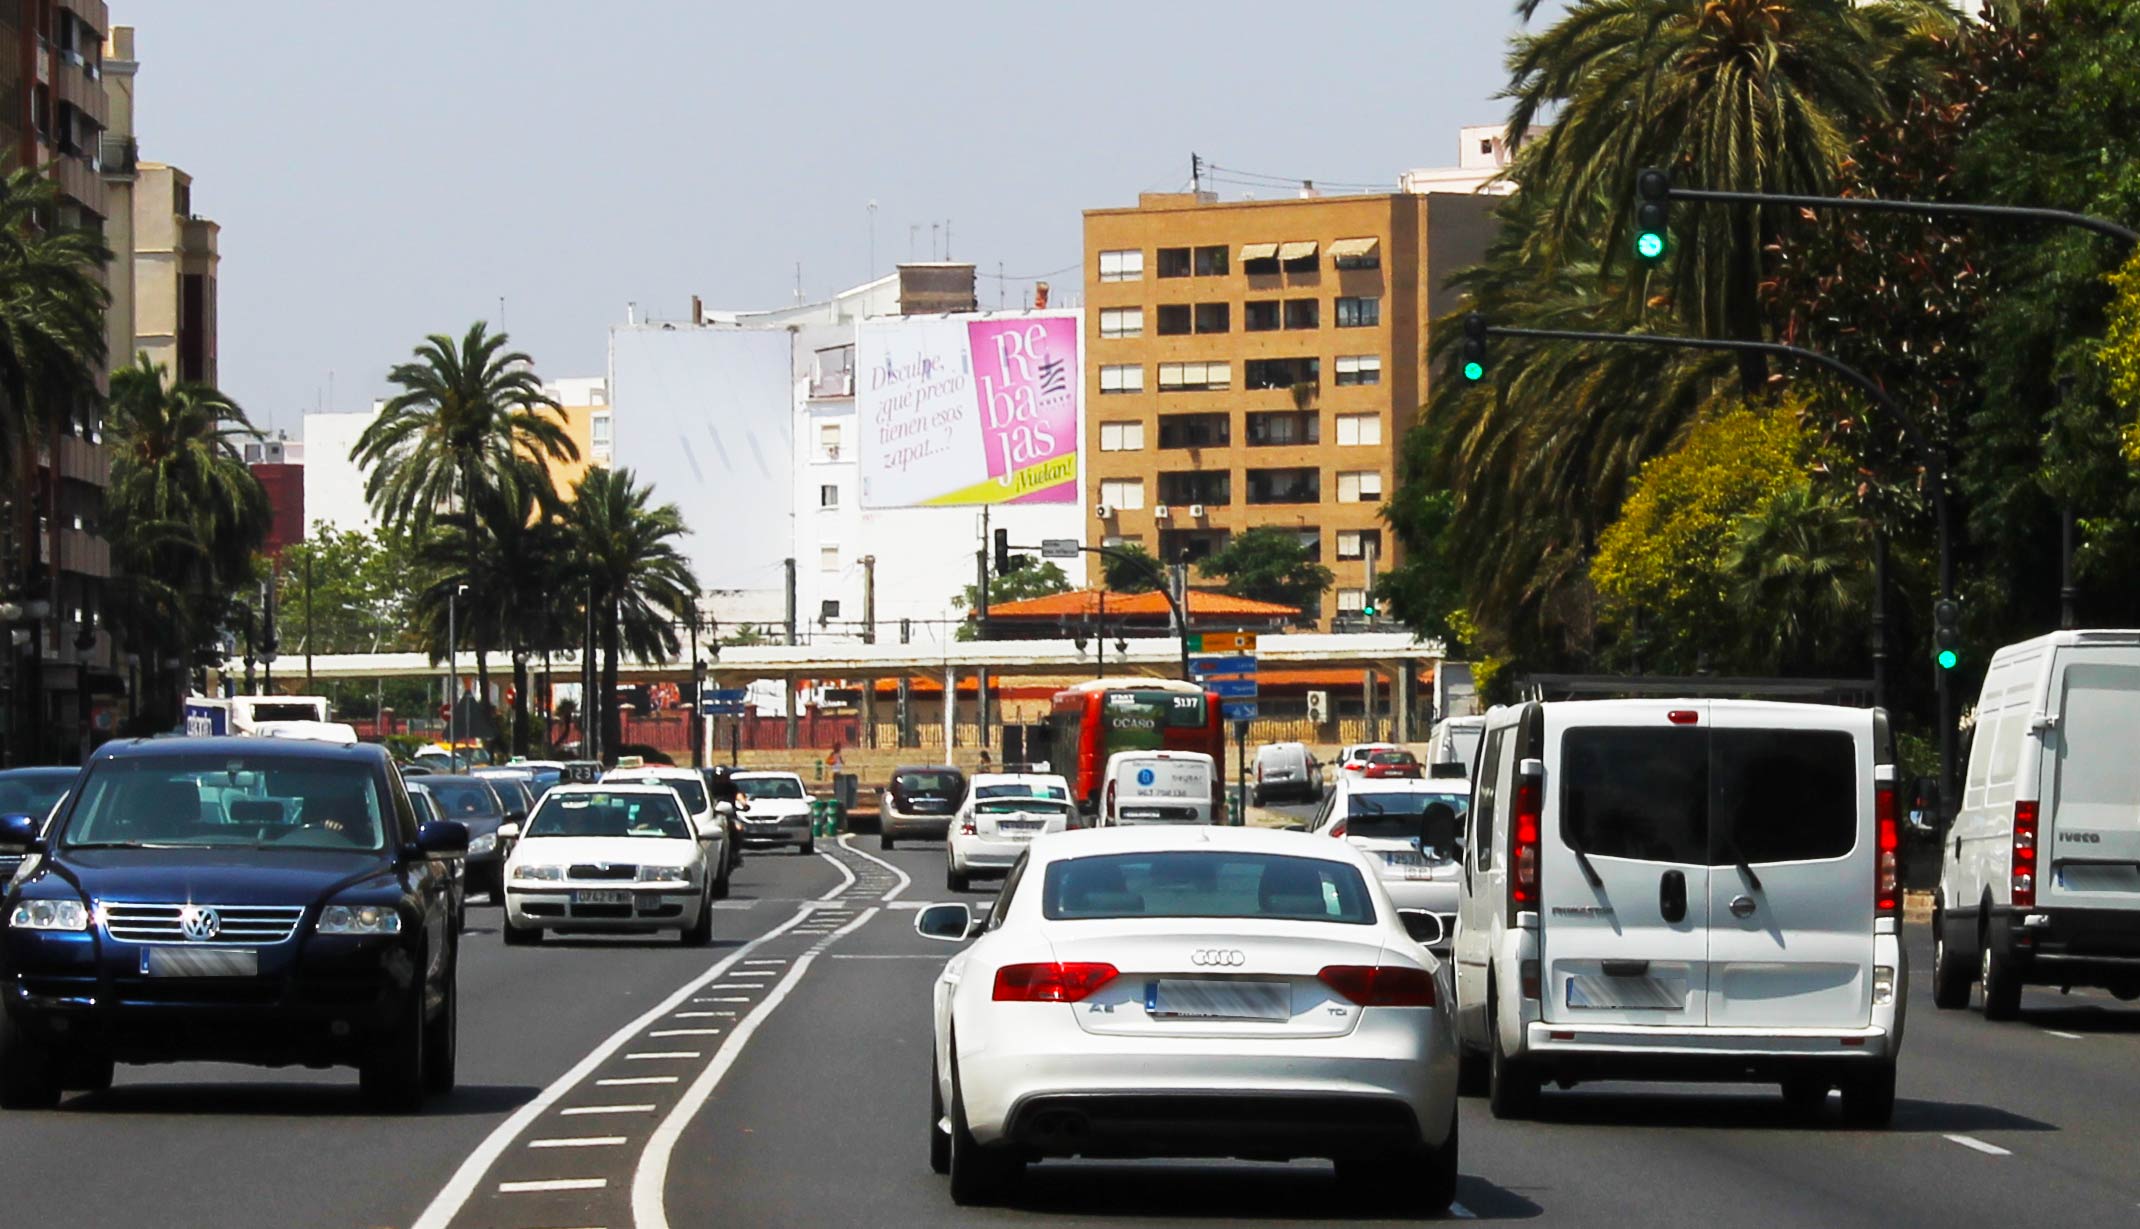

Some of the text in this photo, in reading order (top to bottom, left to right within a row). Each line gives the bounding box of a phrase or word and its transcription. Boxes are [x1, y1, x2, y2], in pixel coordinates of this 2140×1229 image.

[991, 323, 1048, 388] Re
[875, 371, 966, 425] ¿qué precio
[980, 374, 1038, 430] ba
[879, 403, 964, 445] tienen esos
[996, 419, 1056, 488] jas
[1015, 457, 1073, 493] ¡Vuelan!
[1112, 718, 1156, 729] OCASO
[1173, 696, 1199, 709] 5137
